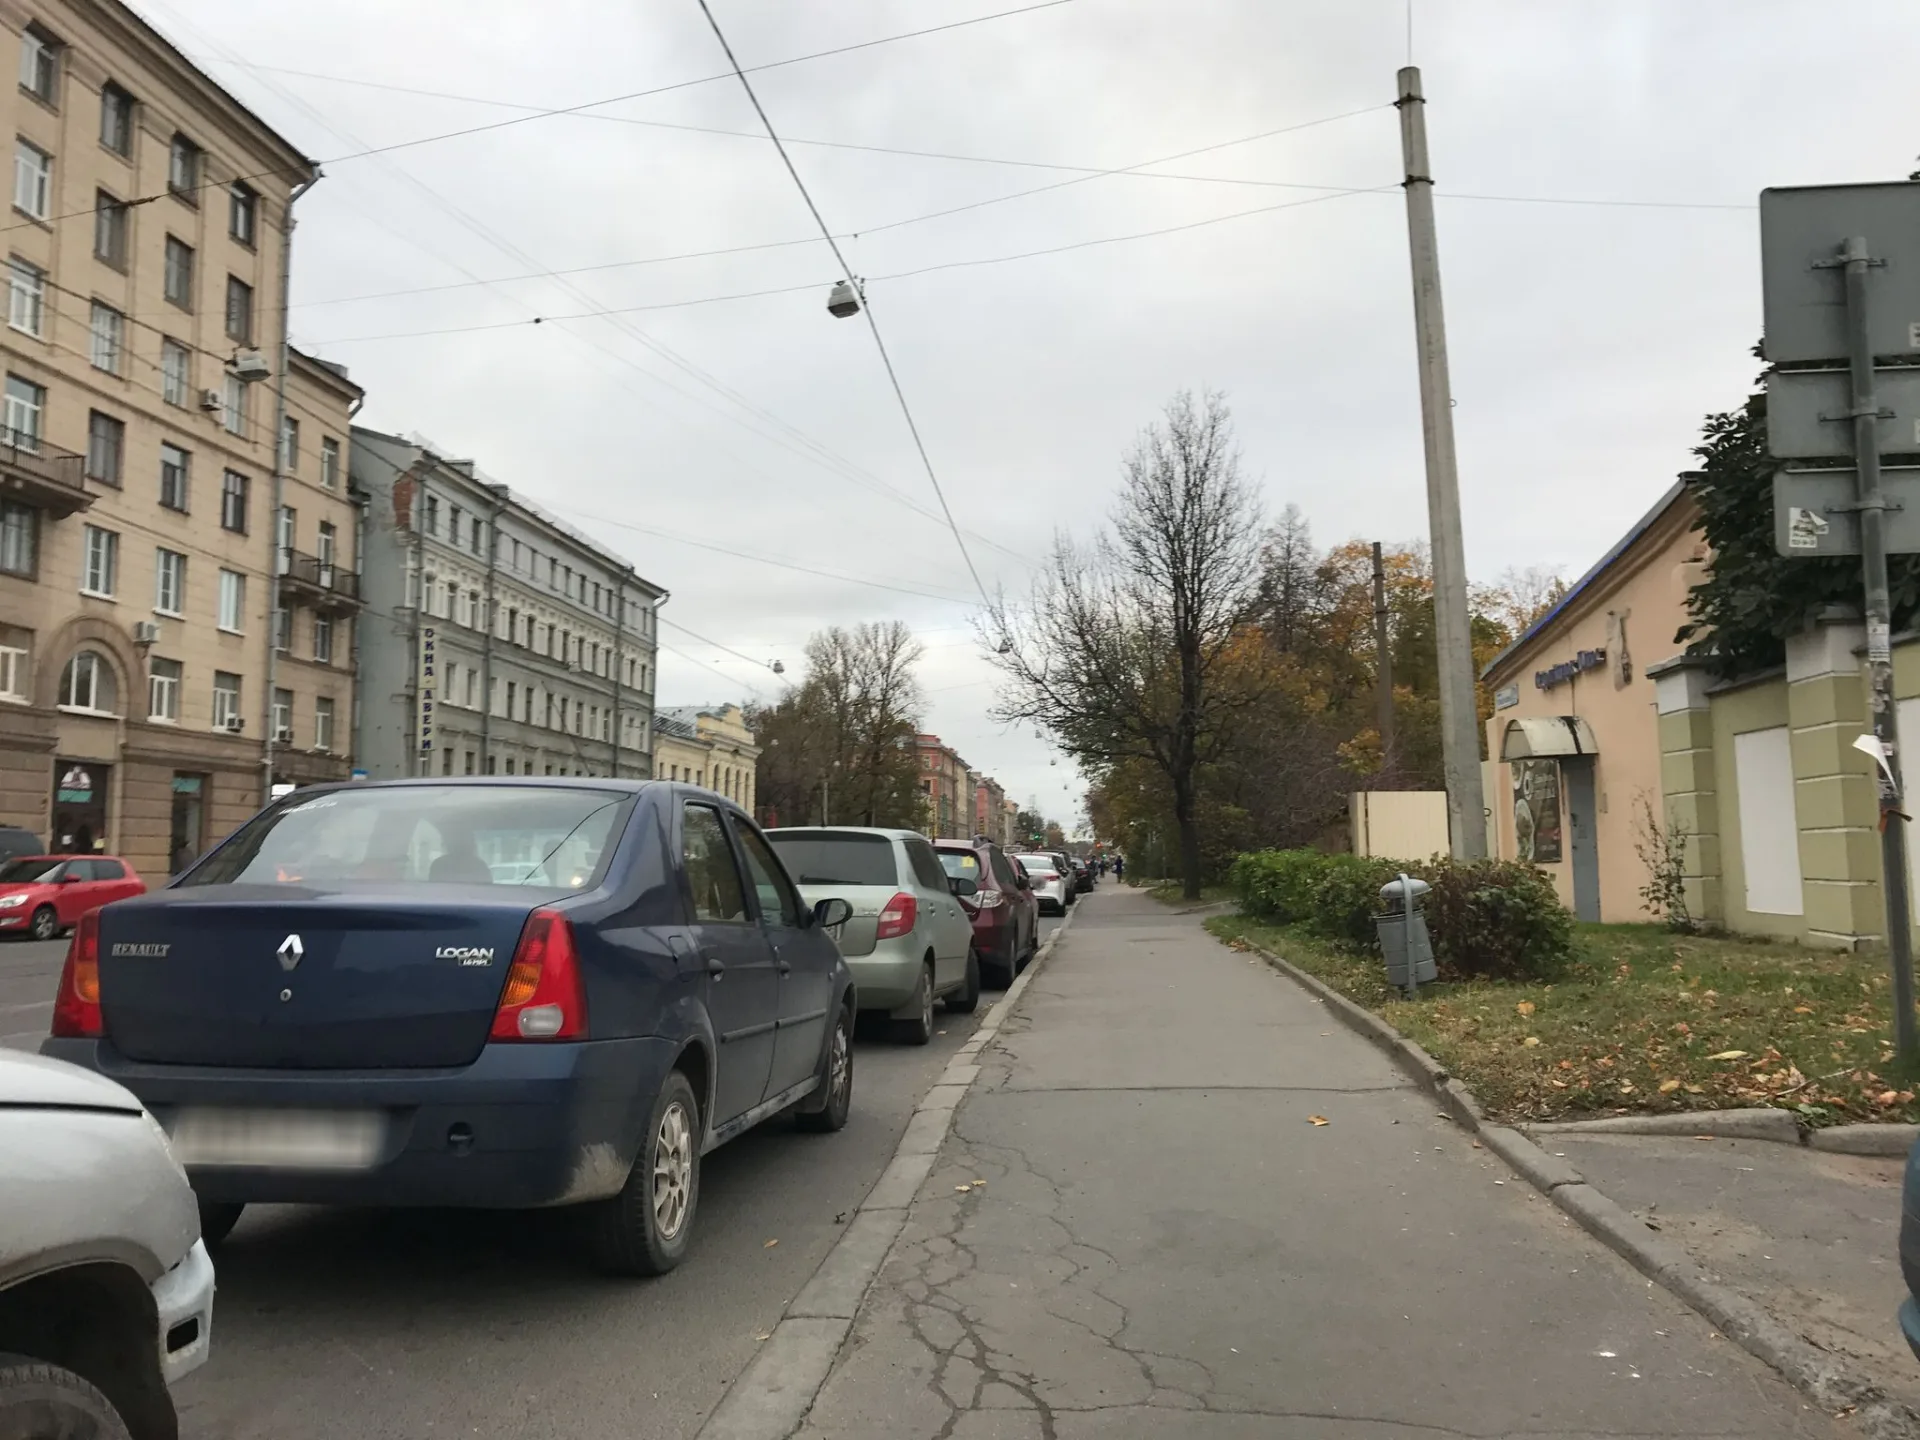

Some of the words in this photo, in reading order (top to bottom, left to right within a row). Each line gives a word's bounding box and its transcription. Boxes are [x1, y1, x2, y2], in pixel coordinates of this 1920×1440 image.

[424, 628, 435, 677] ОКНА
[422, 690, 433, 749] ДВЕРИ
[111, 942, 171, 957] RENAULT
[435, 946, 494, 959] LOGAN
